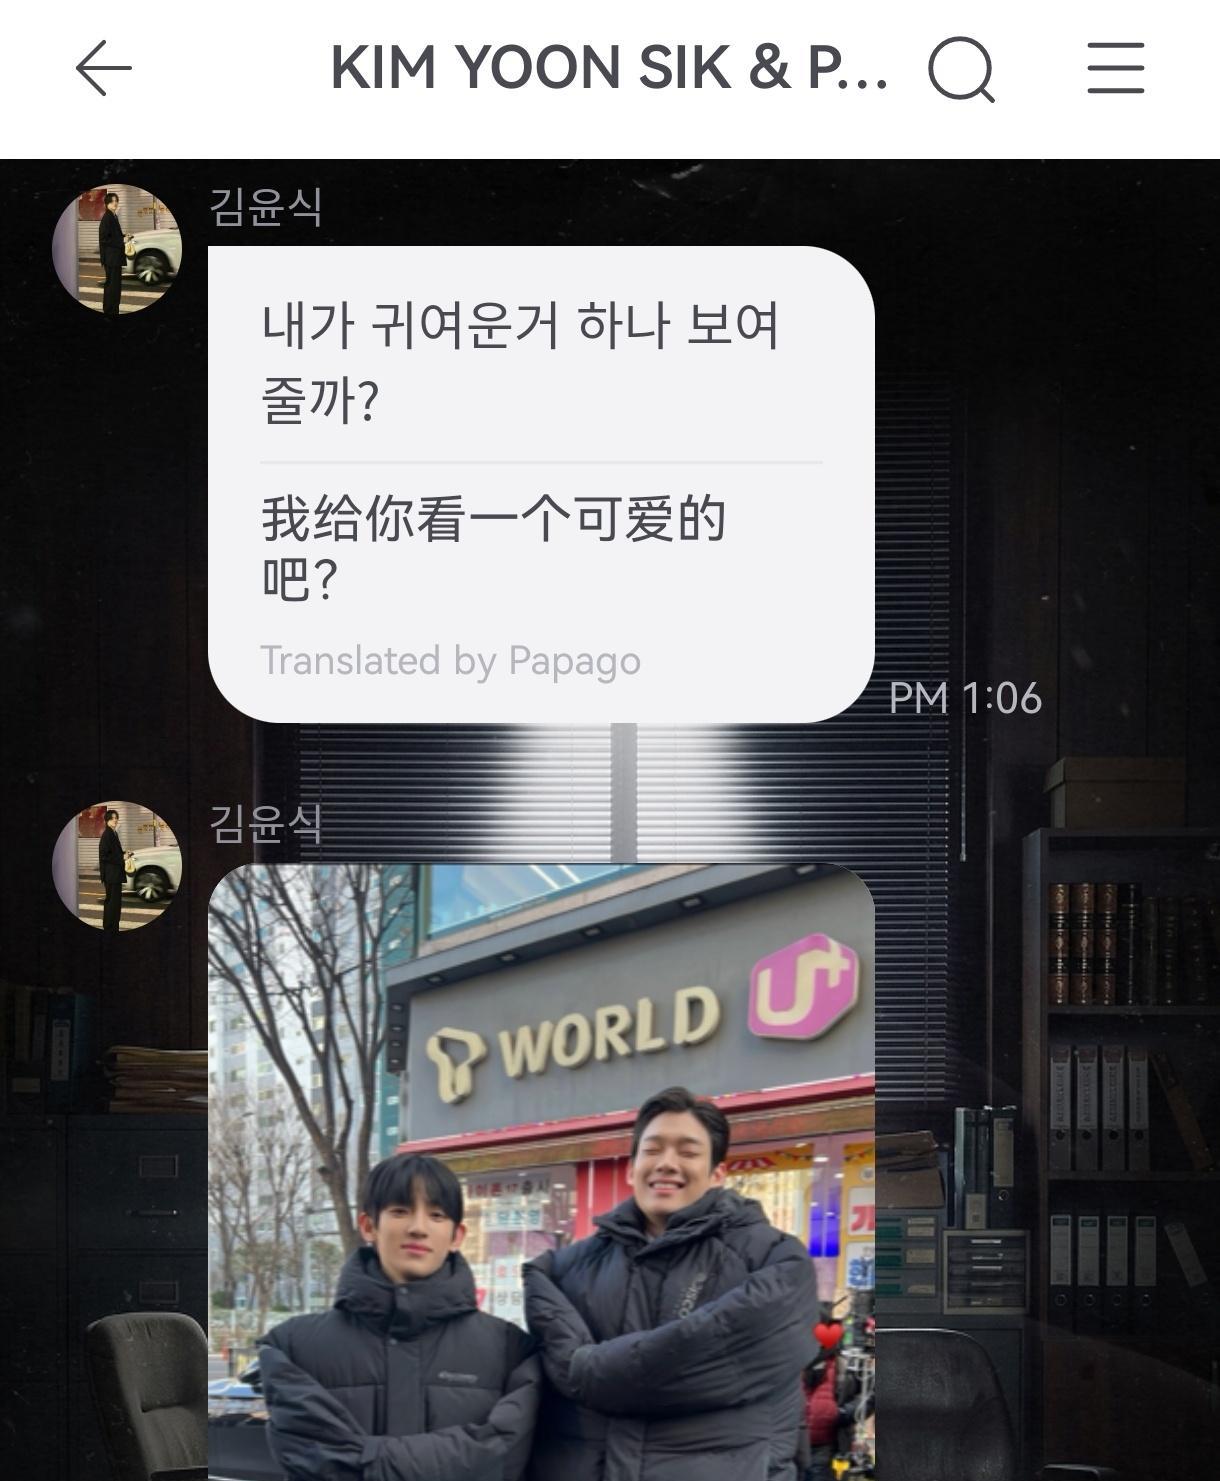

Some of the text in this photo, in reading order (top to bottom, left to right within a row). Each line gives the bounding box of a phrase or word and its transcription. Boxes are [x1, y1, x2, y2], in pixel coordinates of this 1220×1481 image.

[334, 44, 433, 89] KIM
[455, 44, 618, 89] YOON
[640, 44, 731, 89] SIK
[750, 43, 792, 89] &
[210, 187, 322, 229] 김윤식
[264, 300, 777, 351] 내가 귀여운거 하나 보여
[261, 375, 379, 425] 줄까?
[261, 493, 726, 543] 我给你看一个可爱的
[263, 557, 338, 603] 吧?
[260, 643, 641, 684] Translated by Papago
[891, 681, 1041, 713] PM 1:06
[210, 804, 322, 846] 김윤식
[499, 986, 722, 1079] WORLD
